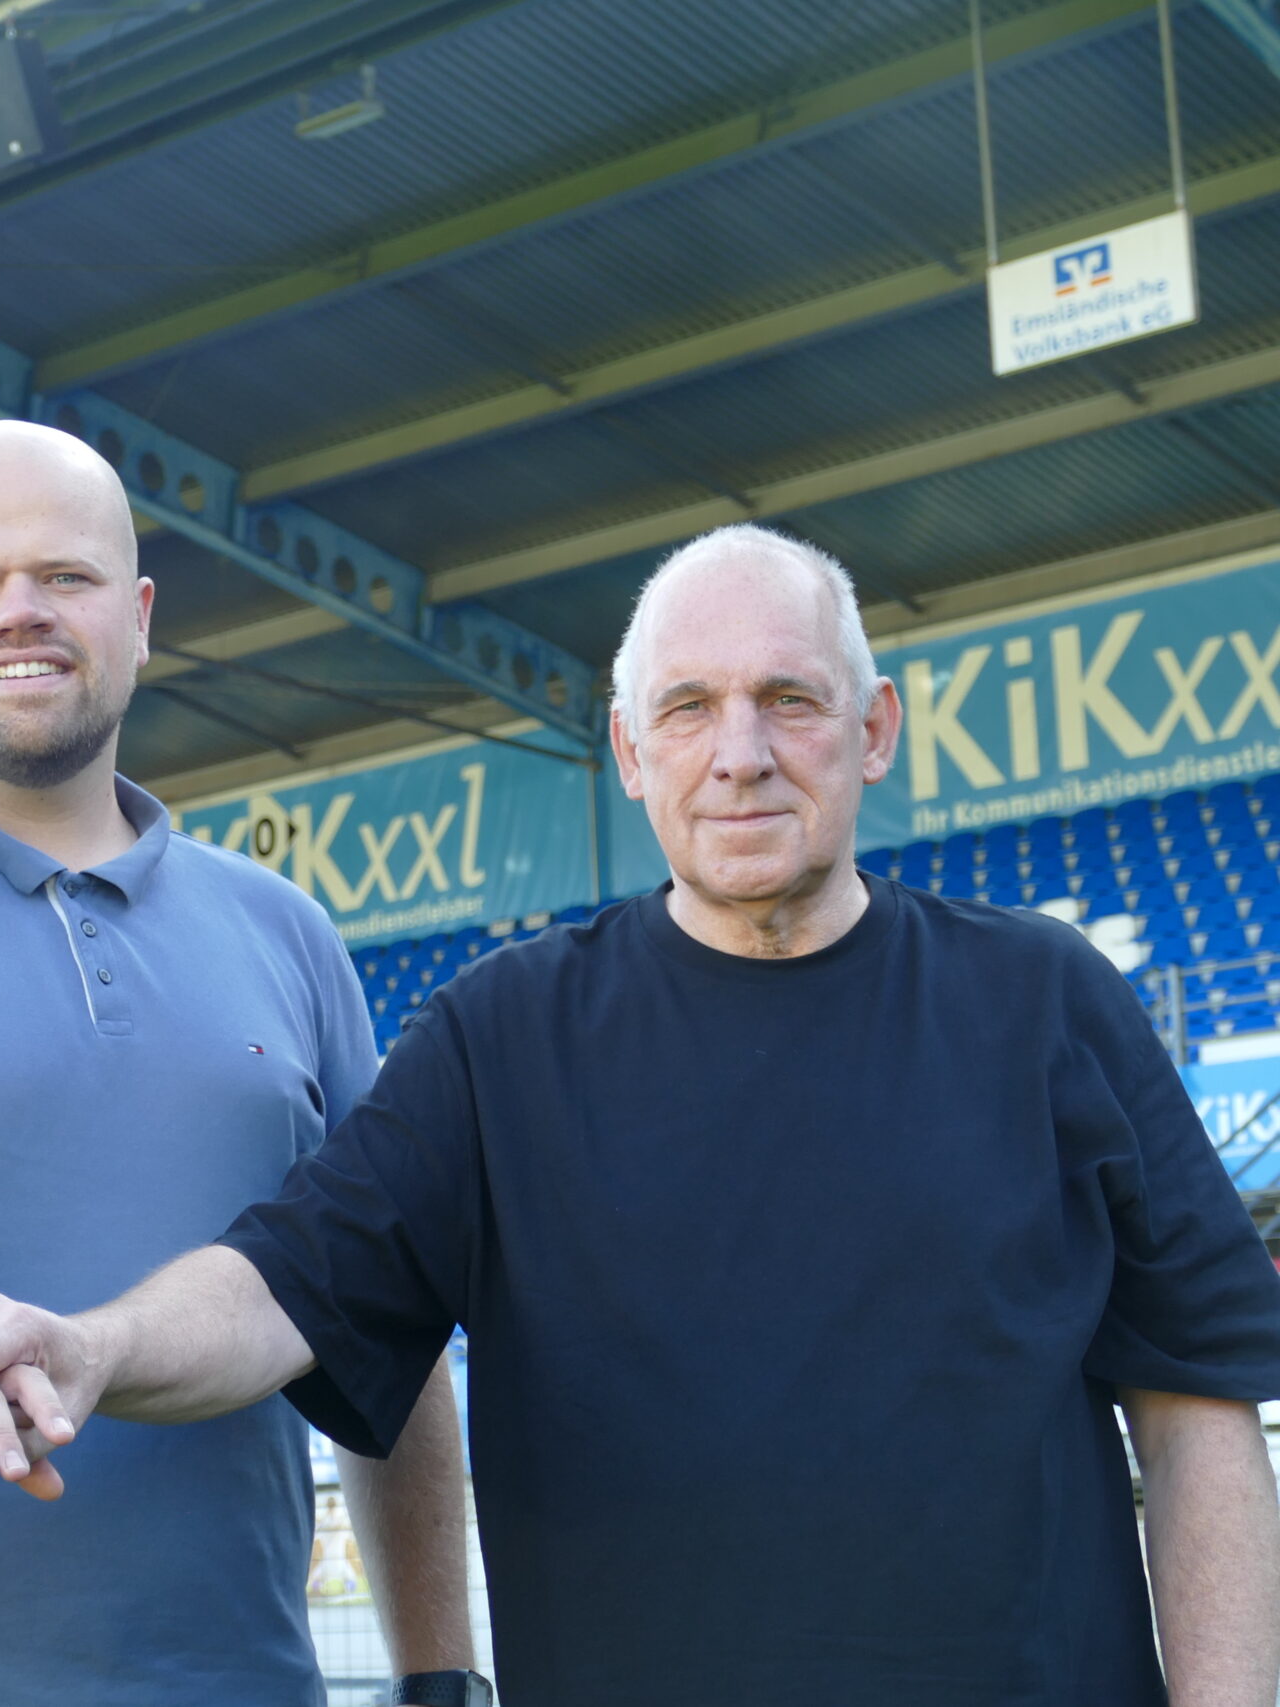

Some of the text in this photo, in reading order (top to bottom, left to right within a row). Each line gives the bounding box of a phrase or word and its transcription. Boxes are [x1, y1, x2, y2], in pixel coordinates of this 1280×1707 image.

[1011, 277, 1168, 334] Emsländische
[1014, 314, 1131, 362] Volksbank
[903, 610, 1280, 801] KiKxx
[913, 741, 1280, 837] Ihr Kommunikationsdienstle
